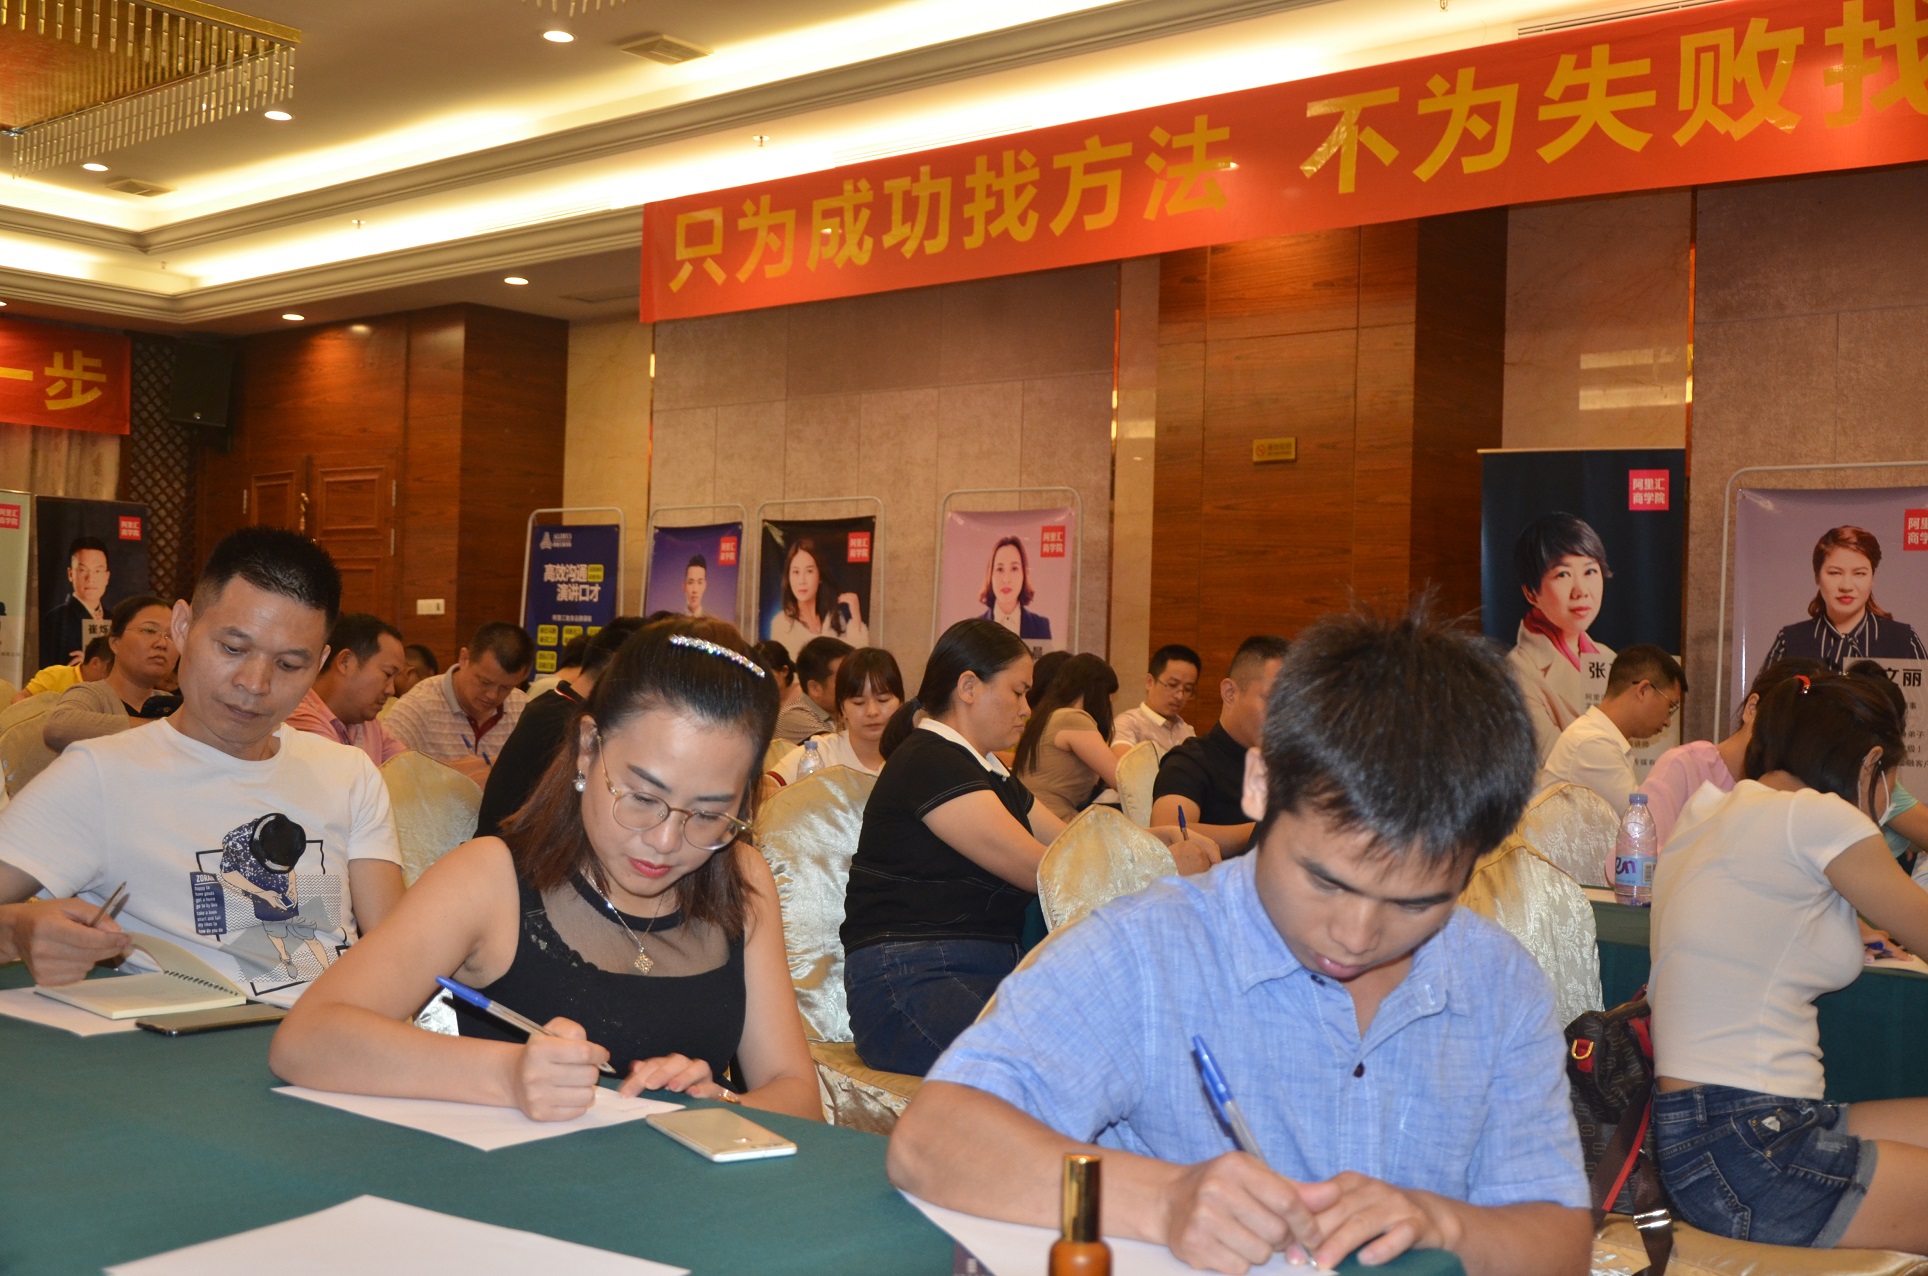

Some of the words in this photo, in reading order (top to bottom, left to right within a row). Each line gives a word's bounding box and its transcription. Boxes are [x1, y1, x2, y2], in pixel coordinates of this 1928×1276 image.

[669, 114, 1231, 293] 只为成功找方法
[1299, 0, 1928, 194] 不为失败找
[0, 350, 107, 410] 一步
[1632, 478, 1665, 490] 阿里汇
[1633, 492, 1665, 504] 商学院
[850, 538, 869, 547] 阿里汇
[1043, 532, 1063, 541] 阿里汇
[850, 549, 868, 558] 商学院
[1042, 543, 1063, 553] 商学院
[544, 563, 587, 582] 高效沟通
[557, 584, 601, 602] 演讲口才
